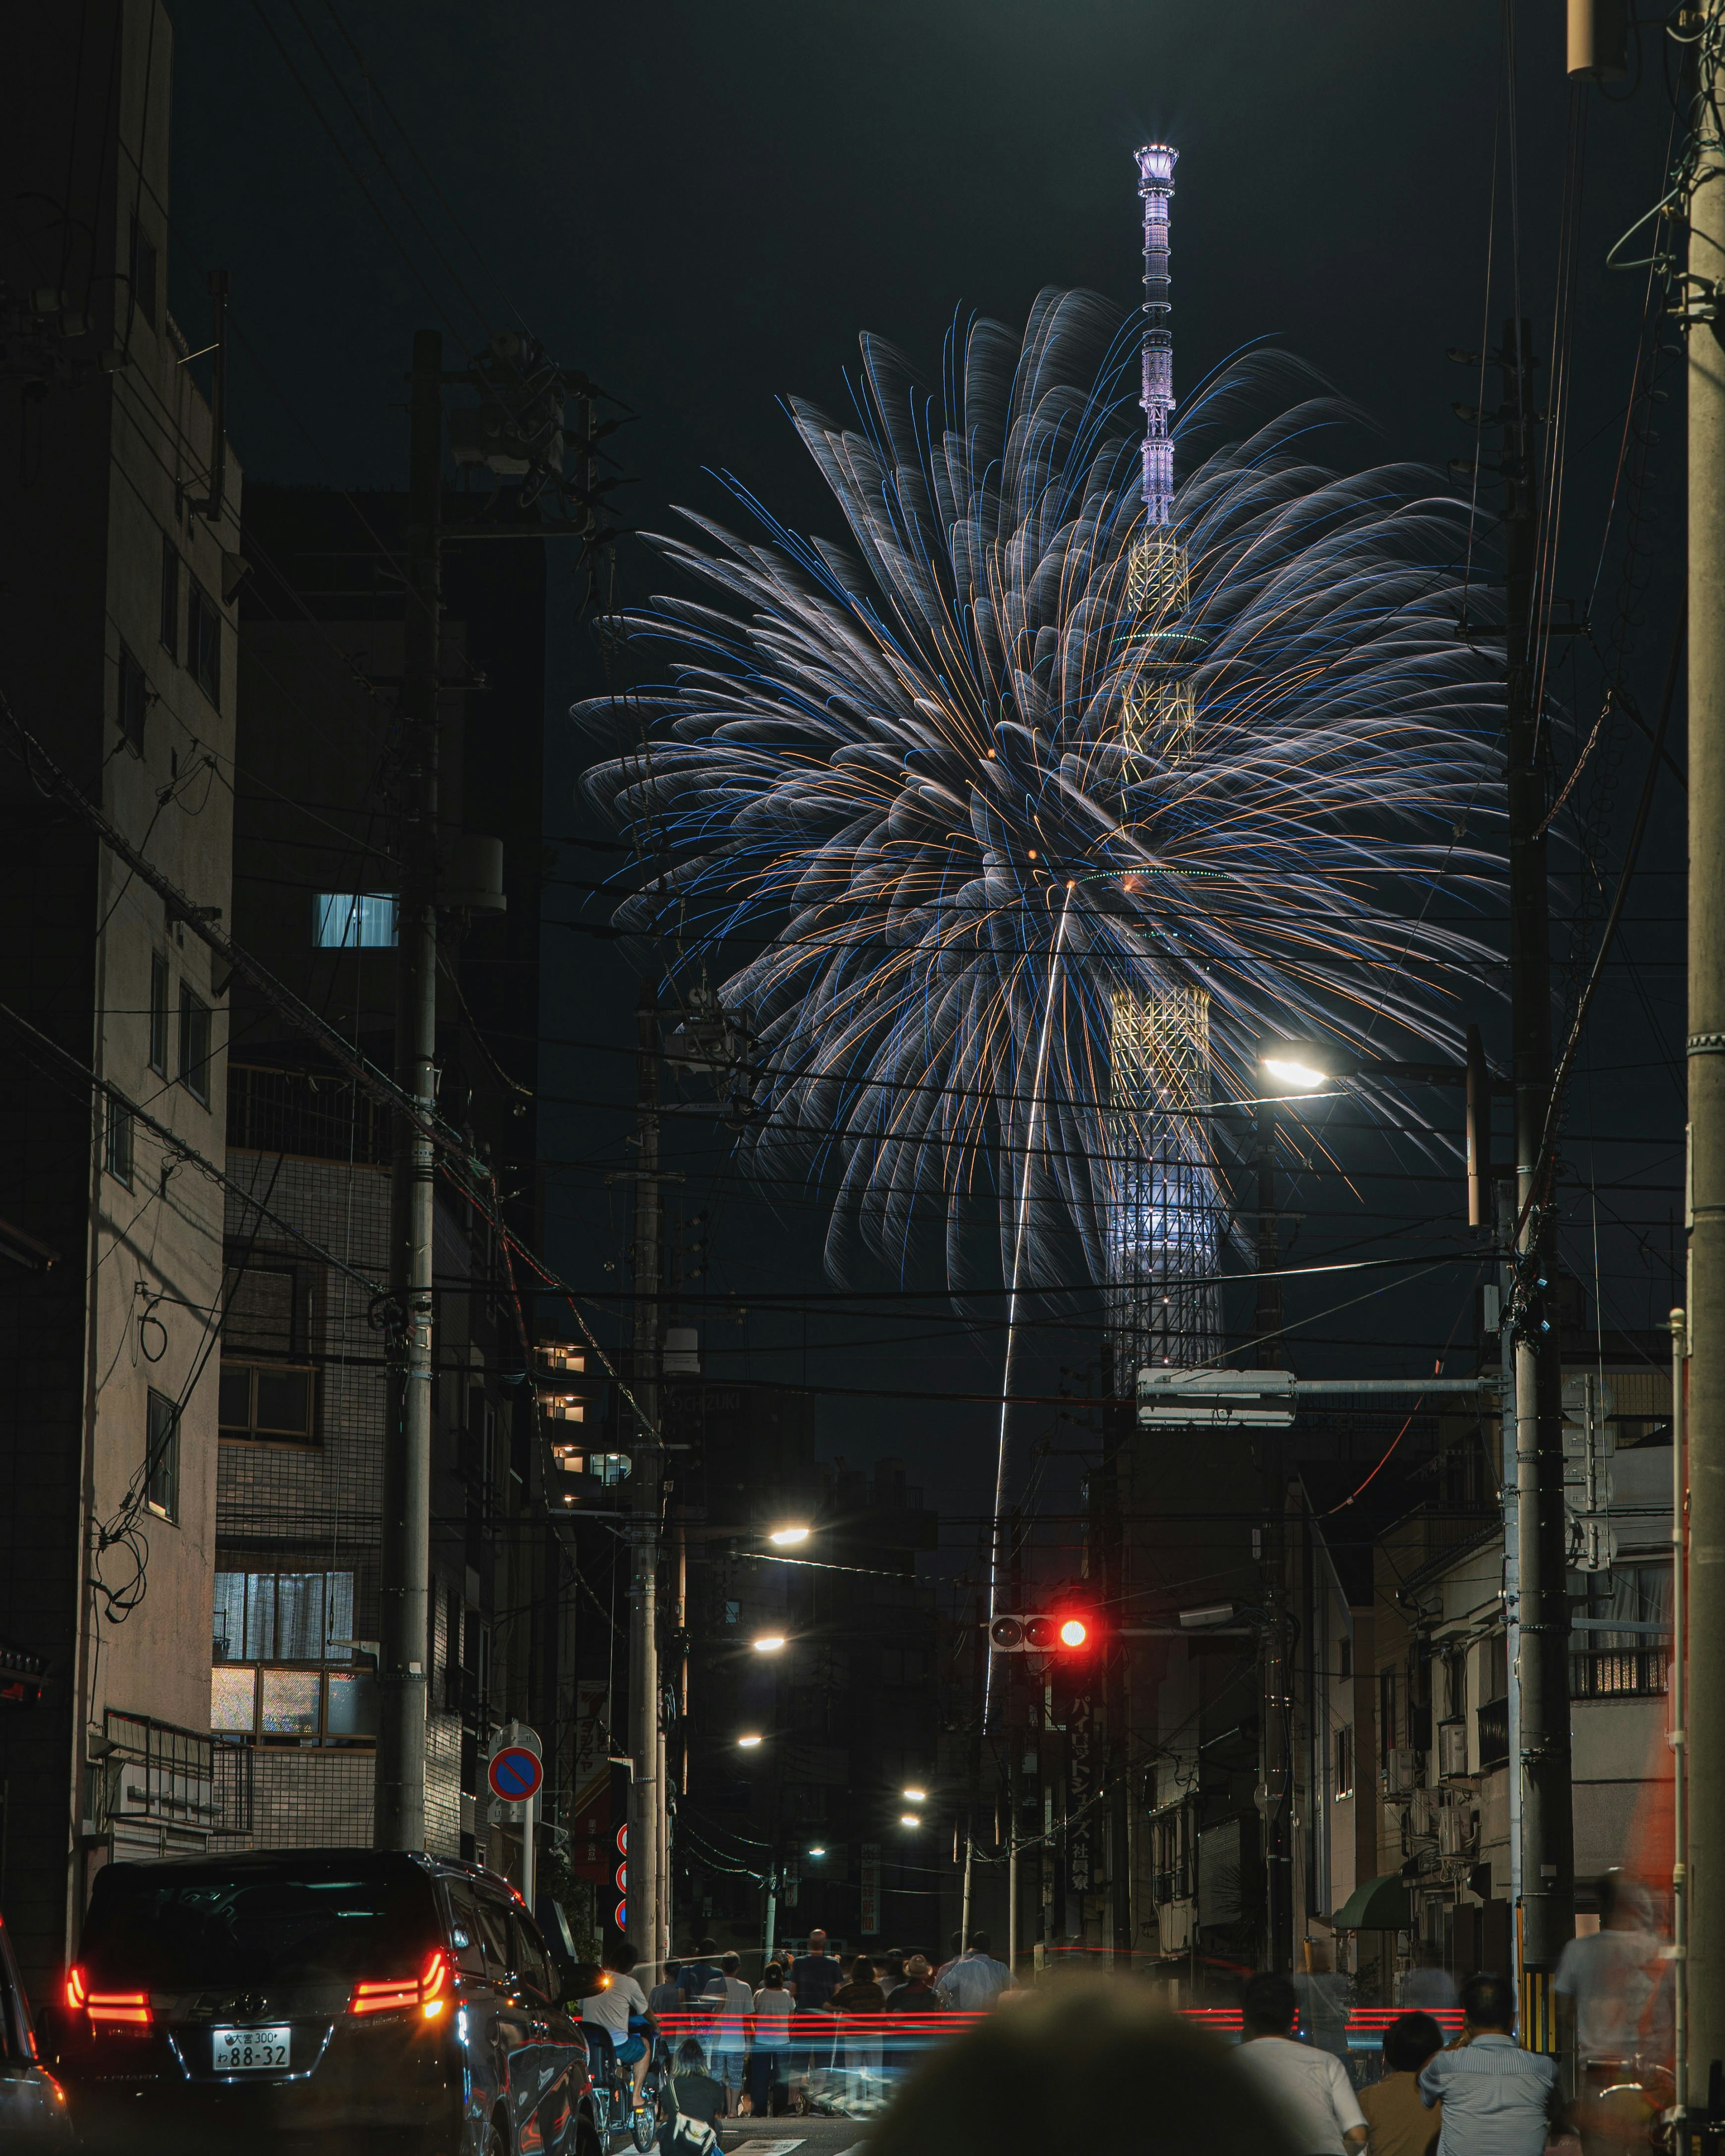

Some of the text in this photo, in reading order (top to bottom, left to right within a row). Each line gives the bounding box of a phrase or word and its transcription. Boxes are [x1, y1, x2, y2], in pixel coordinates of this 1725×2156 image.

[233, 2032, 273, 2044] 大宮 300
[218, 2045, 286, 2066] わ 88-32
